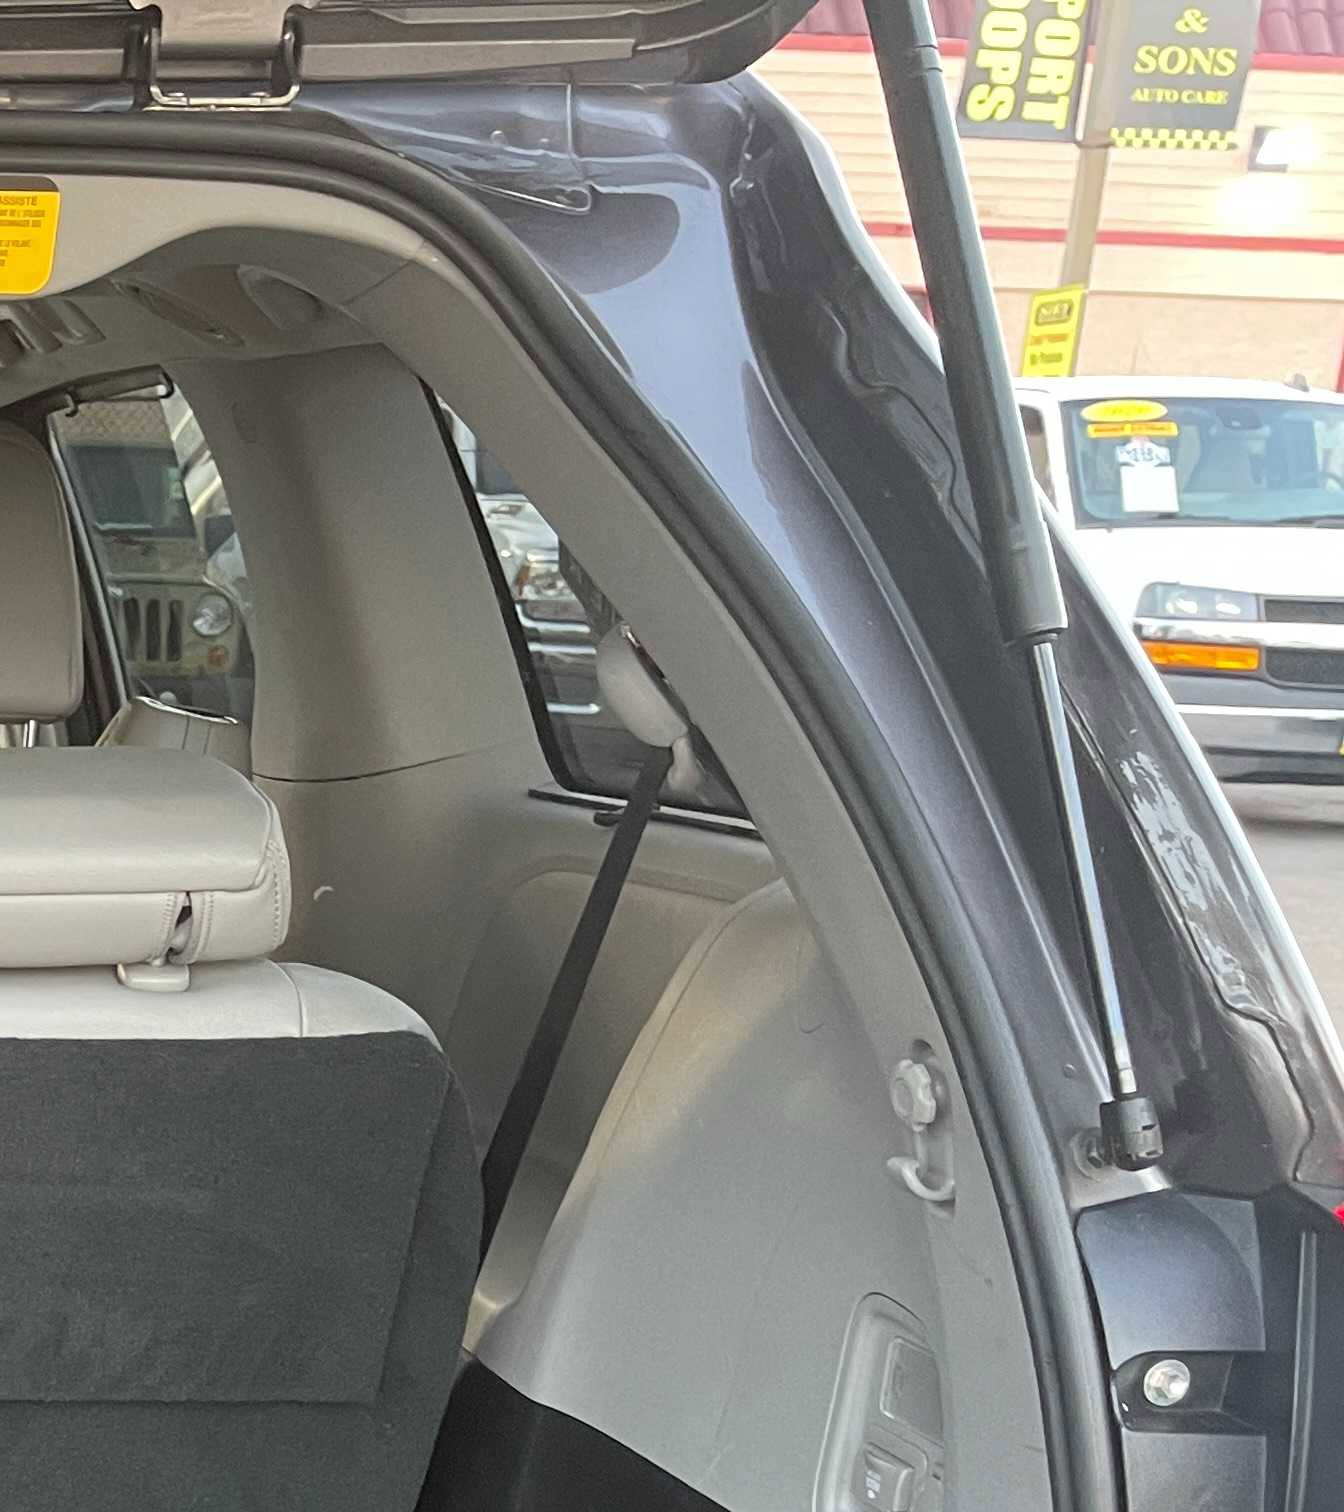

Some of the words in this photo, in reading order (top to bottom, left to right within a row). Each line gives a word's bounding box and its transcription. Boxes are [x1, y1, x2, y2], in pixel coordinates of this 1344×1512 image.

[1174, 8, 1210, 33] &
[966, 0, 1031, 122] OPS
[1134, 45, 1237, 76] SONS
[1130, 88, 1179, 104] AUTO
[1180, 88, 1227, 105] CARE
